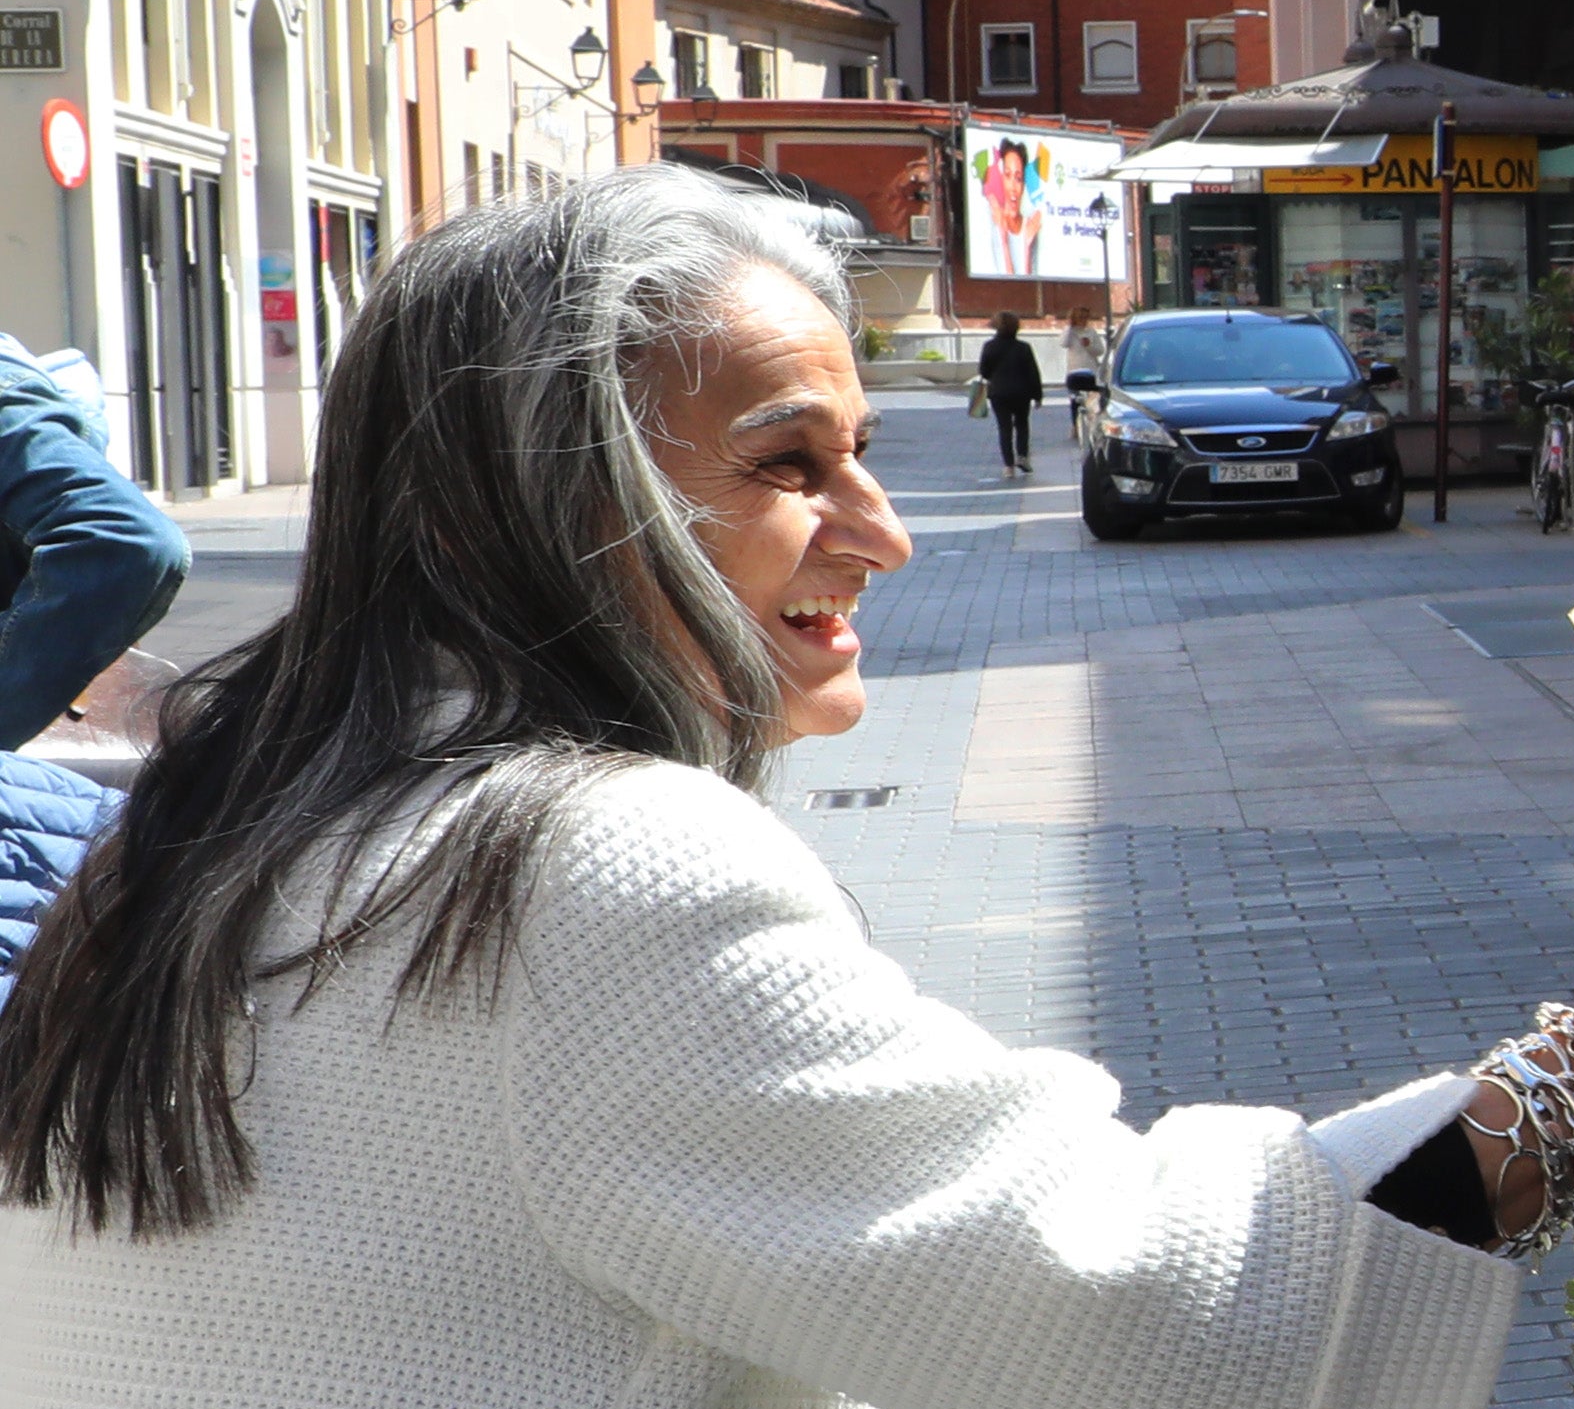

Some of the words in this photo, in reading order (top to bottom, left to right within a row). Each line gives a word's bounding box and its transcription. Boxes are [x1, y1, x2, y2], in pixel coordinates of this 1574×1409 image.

[2, 14, 51, 28] Corral
[1361, 157, 1535, 189] PANALON
[1220, 466, 1257, 480] 7354
